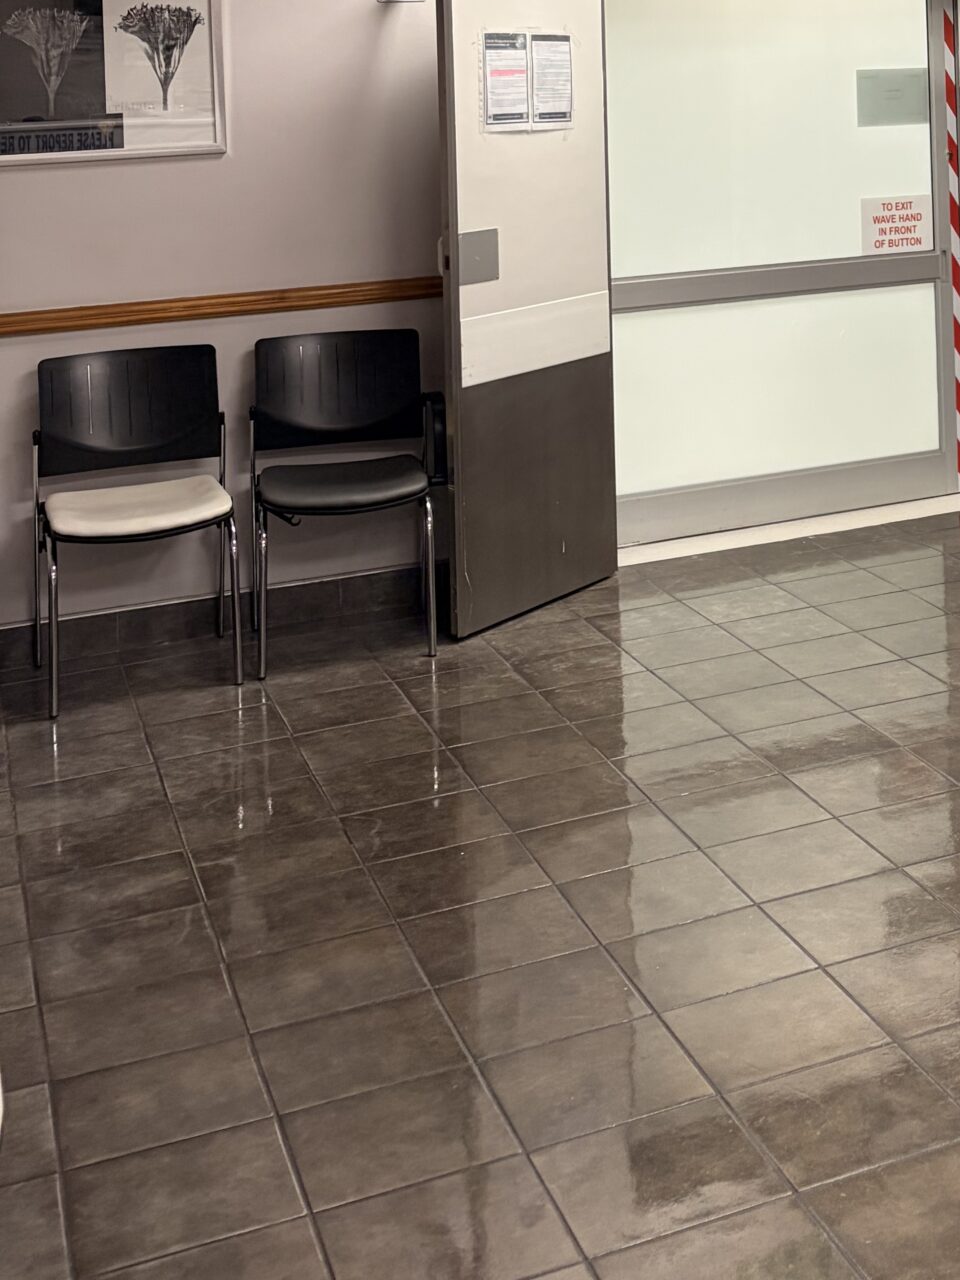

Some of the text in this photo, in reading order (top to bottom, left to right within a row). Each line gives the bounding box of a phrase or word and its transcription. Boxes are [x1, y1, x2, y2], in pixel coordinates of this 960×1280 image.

[881, 201, 913, 212] TO EXIT
[872, 213, 922, 224] WAVE HAND
[878, 225, 917, 236] IN FRONT
[874, 237, 922, 249] OF BUTTON
